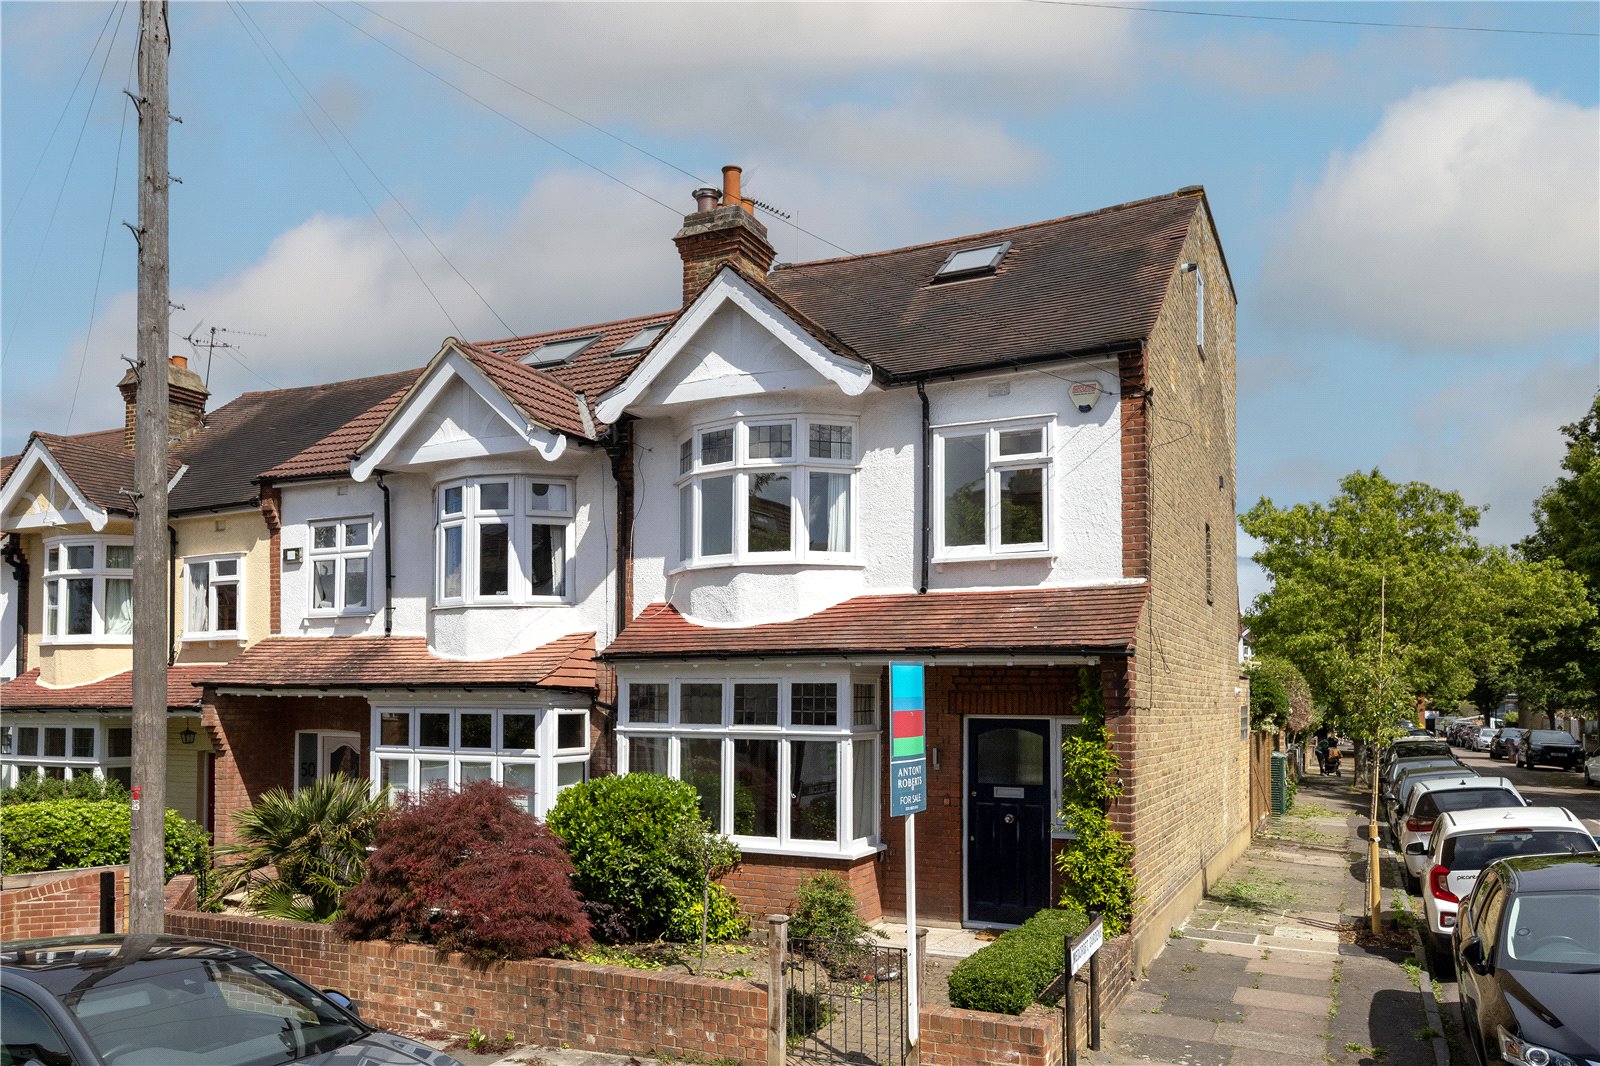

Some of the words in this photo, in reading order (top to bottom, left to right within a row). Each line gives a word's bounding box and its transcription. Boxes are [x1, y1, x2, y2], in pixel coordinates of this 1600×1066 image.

[301, 762, 315, 777] 50
[898, 765, 922, 777] ANTONY
[897, 777, 922, 789] ROBERTS
[900, 795, 912, 805] FOR
[912, 794, 922, 803] SALE
